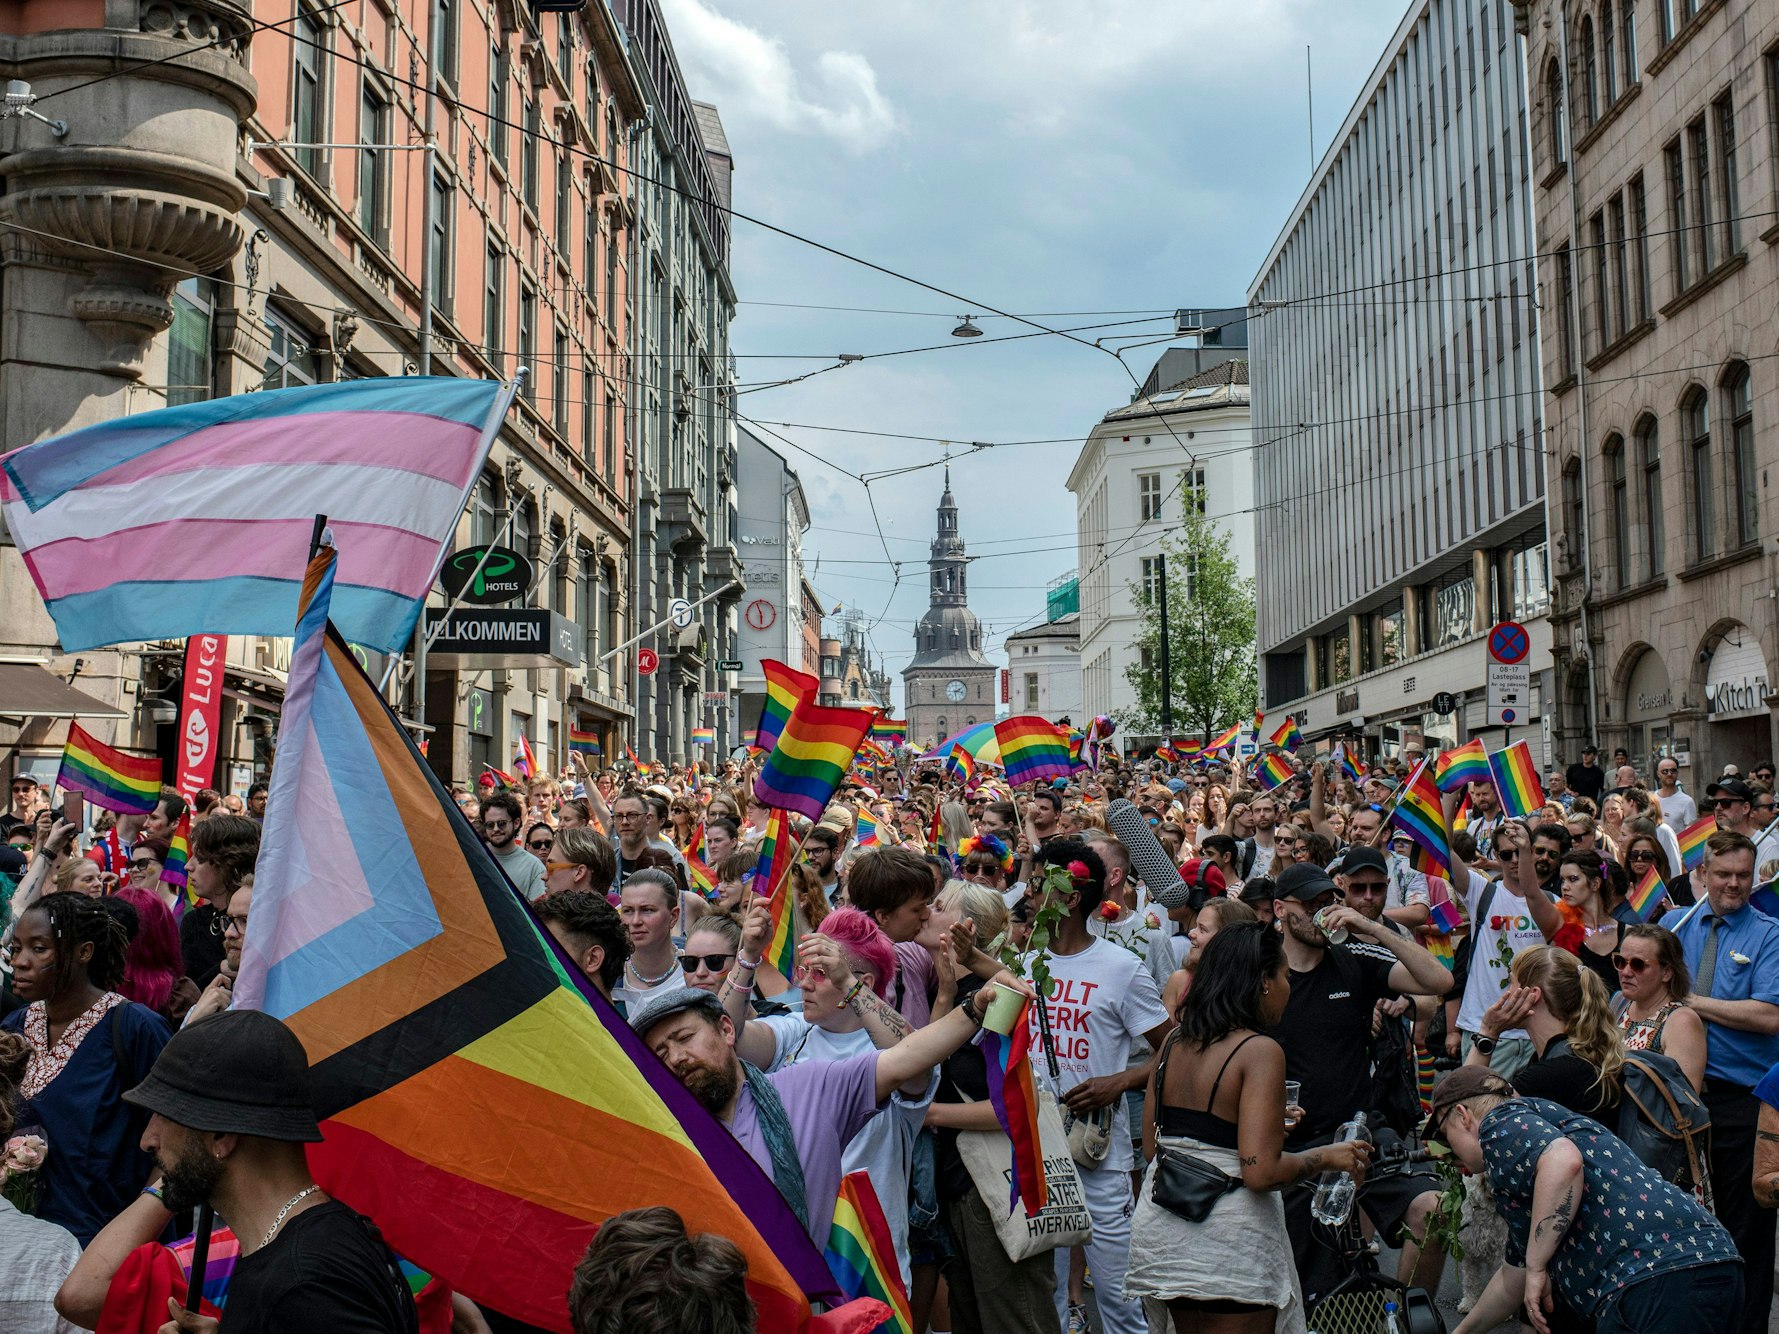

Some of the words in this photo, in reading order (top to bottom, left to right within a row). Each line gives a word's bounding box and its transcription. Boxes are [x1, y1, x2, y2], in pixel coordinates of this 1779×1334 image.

[486, 582, 519, 591] HOTELS
[676, 608, 687, 624] T
[559, 628, 573, 651] HOTEL
[189, 636, 219, 705] Luca
[1492, 673, 1526, 681] Lasteplass
[1027, 1216, 1063, 1238] HVER
[1064, 1213, 1090, 1232] KVELD
